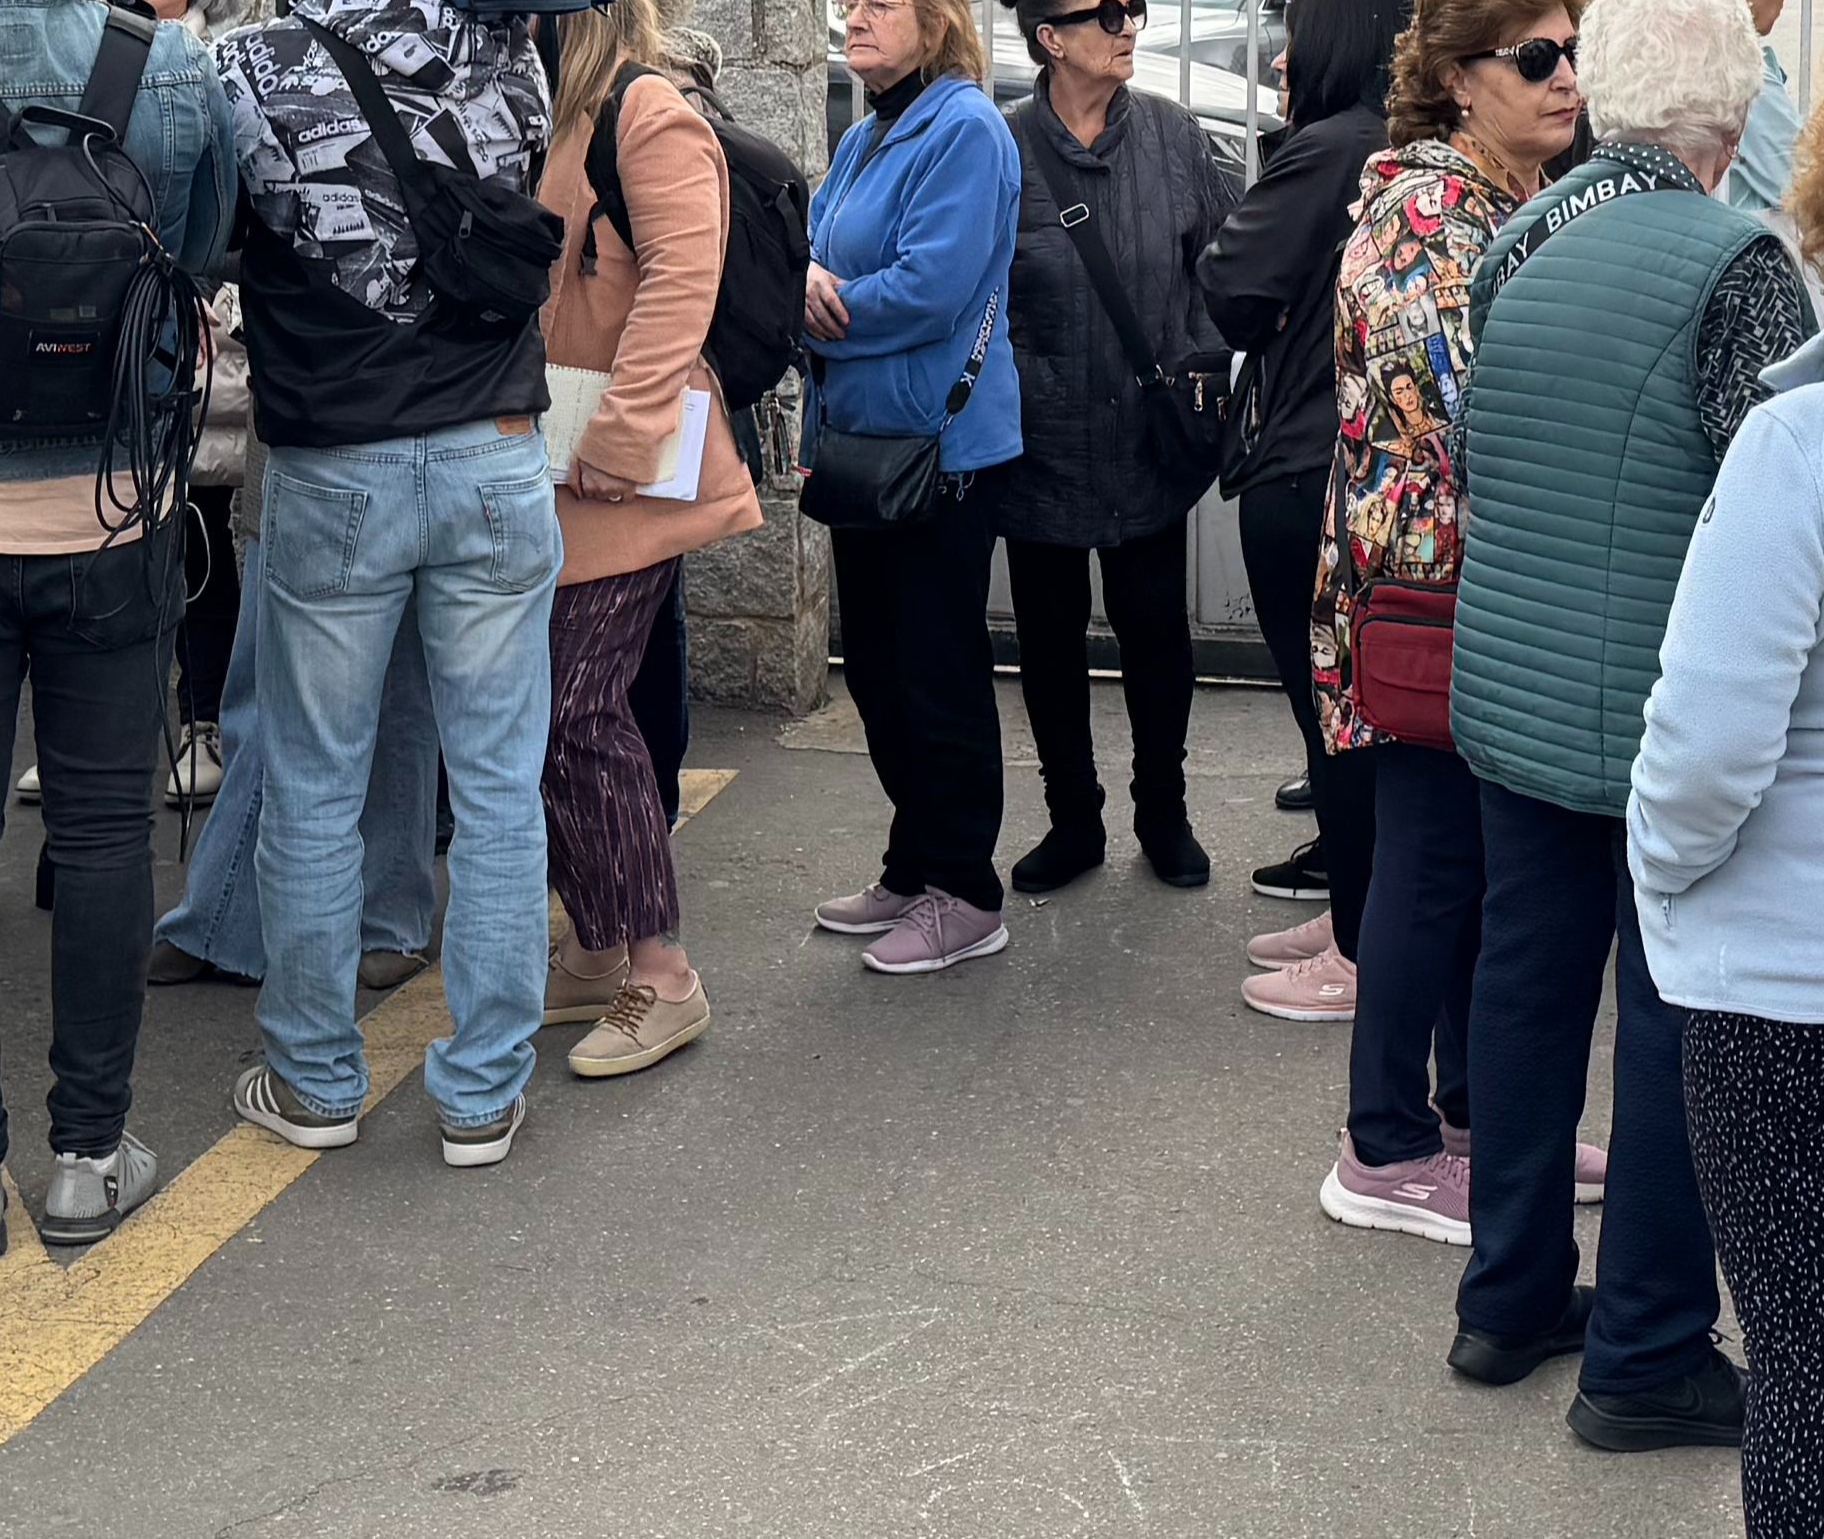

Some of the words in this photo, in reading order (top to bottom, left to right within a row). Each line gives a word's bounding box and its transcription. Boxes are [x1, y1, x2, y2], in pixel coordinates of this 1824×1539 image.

[298, 118, 362, 143] adidas
[1545, 170, 1658, 234] BIMBAY
[1492, 232, 1530, 296] BAY
